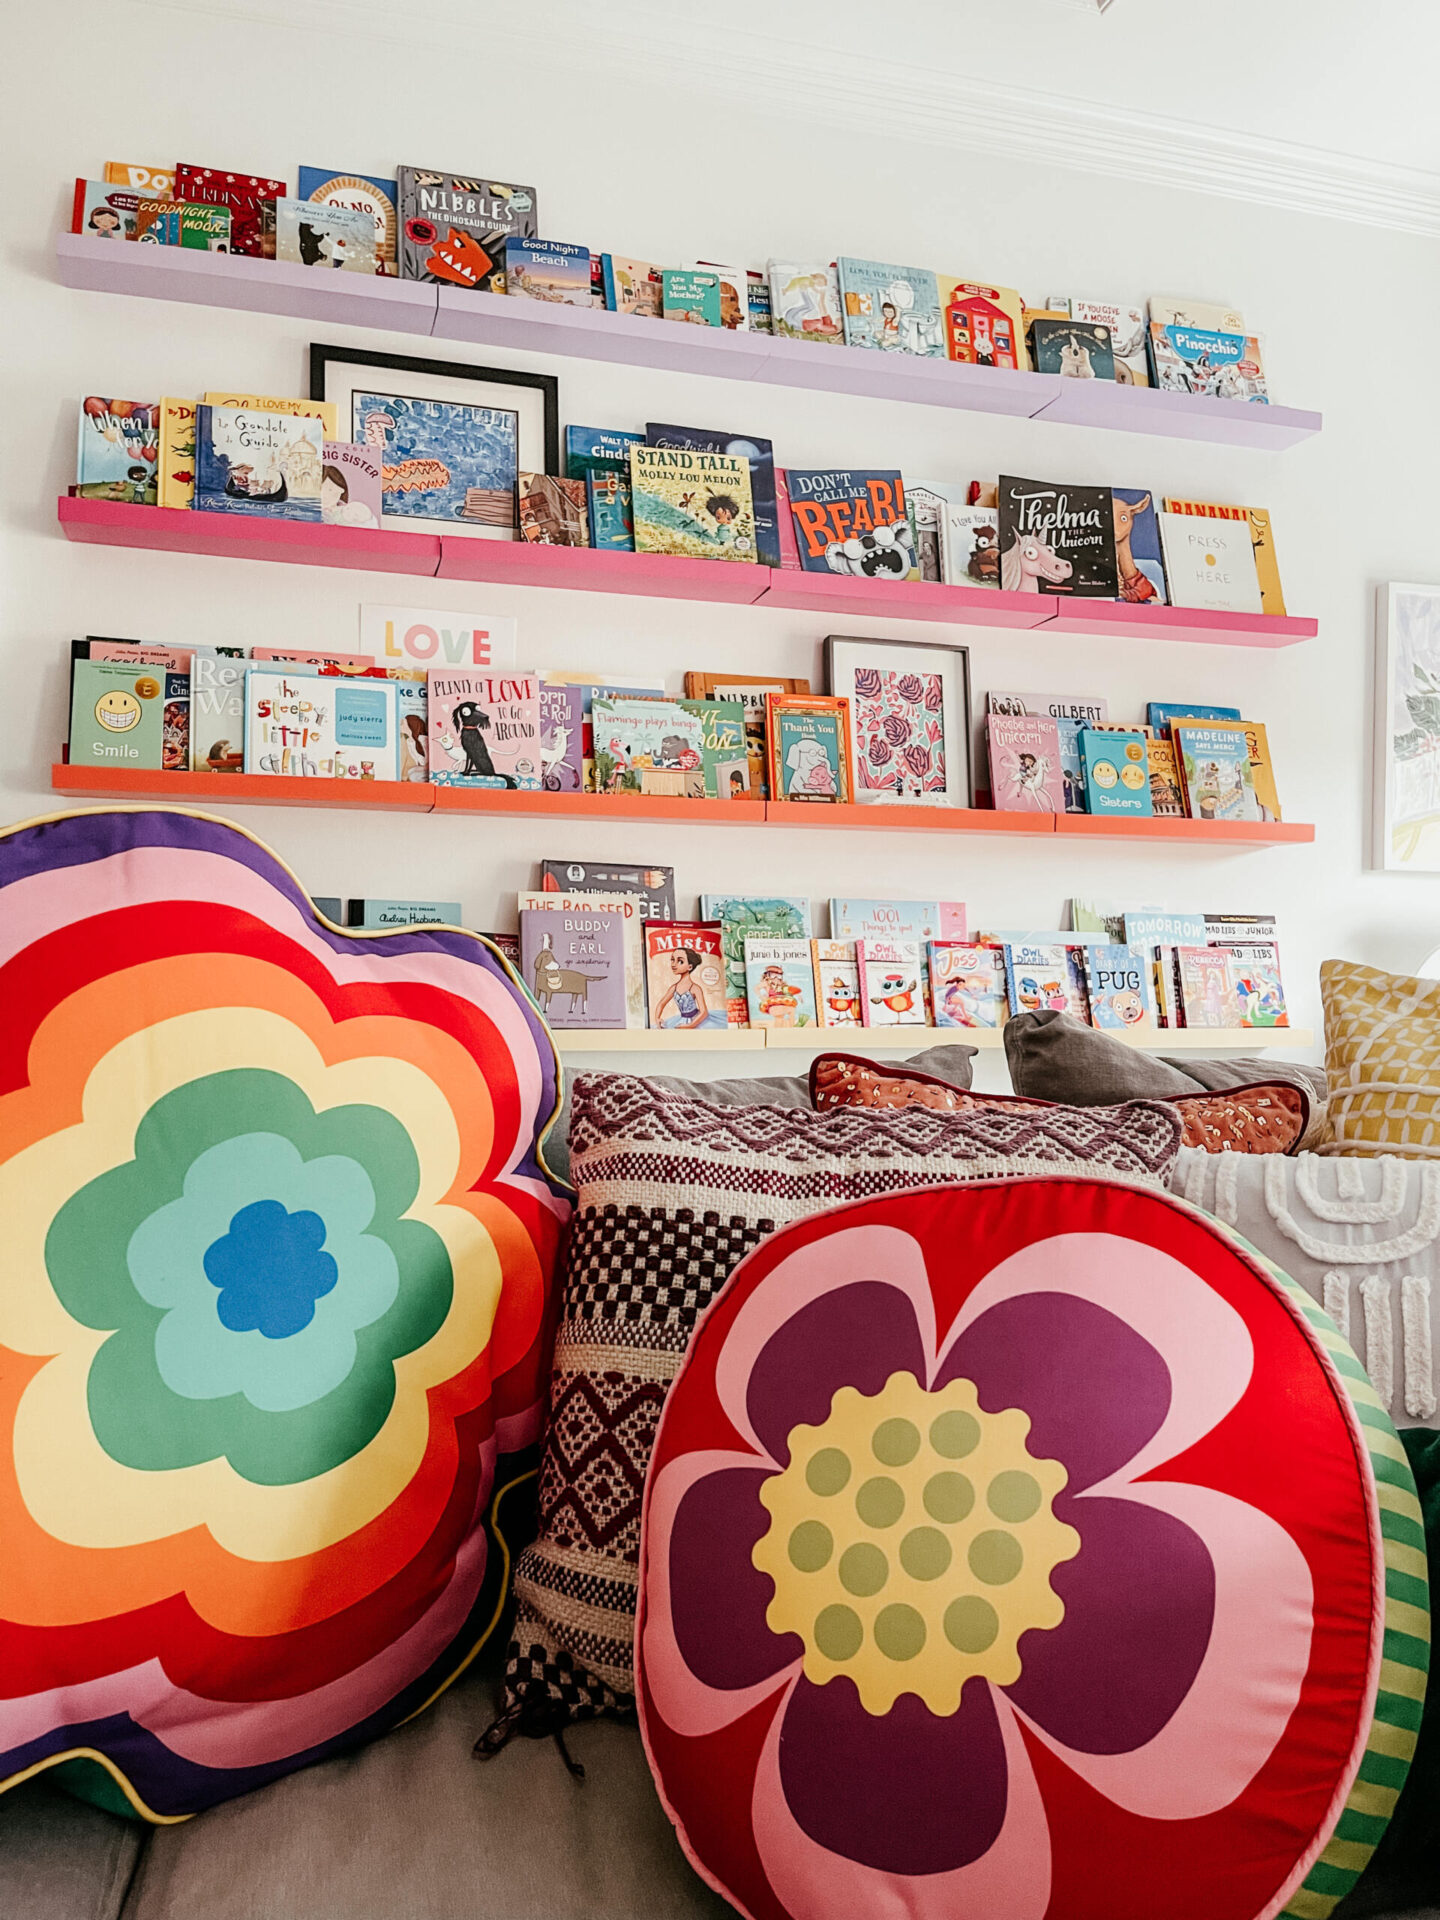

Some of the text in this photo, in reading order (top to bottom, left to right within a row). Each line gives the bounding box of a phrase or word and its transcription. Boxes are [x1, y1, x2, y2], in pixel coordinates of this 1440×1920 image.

[140, 202, 217, 219] GOODNIGHT
[421, 189, 513, 221] NIBBLES
[183, 220, 230, 233] MOON
[428, 211, 512, 232] THE DINOSAUR GUIDE
[522, 240, 579, 255] Good Night
[532, 253, 568, 267] Beach
[1078, 303, 1120, 315] IF YOU GIVE
[1090, 314, 1116, 324] MOOSE
[1175, 334, 1239, 356] Pinocchio
[263, 400, 284, 410] LOVE
[285, 402, 301, 411] MY
[88, 410, 144, 433] When
[600, 435, 621, 446] WALT
[342, 453, 379, 479] SISTER
[637, 449, 693, 470] STAND
[639, 470, 740, 486] MOLLY LOU MELON
[797, 473, 851, 494] DON'T
[814, 487, 868, 502] CALL ME
[1010, 488, 1103, 531] Thelma
[791, 479, 906, 557] BEAR!
[1052, 530, 1104, 549] Unicorn
[1068, 529, 1085, 537] THE
[1189, 535, 1227, 549] PRESS
[1196, 570, 1231, 584] HERE
[385, 621, 491, 665] LOVE
[434, 679, 472, 697] PLENTY
[485, 679, 535, 703] LOVE
[552, 706, 572, 725] Roll
[1049, 704, 1102, 721] GILBERT
[495, 723, 535, 741] AROUND
[597, 715, 697, 734] Flamingo plays bingo
[783, 722, 834, 734] Thank You
[992, 718, 1025, 731] Phoebe
[1037, 720, 1056, 734] Her
[995, 728, 1043, 747] Unicorn
[1186, 730, 1241, 743] MADELINE
[93, 742, 140, 758] Smile
[1100, 795, 1142, 809] Sisters
[563, 899, 592, 912] BAD
[600, 902, 633, 918] SEED
[873, 909, 899, 922] 1001
[380, 913, 407, 926] Audrey
[564, 919, 610, 933] BUDDY
[1128, 918, 1204, 937] TOMORROW
[737, 925, 784, 942] General
[1205, 926, 1220, 935] MAD
[1245, 926, 1274, 936] JUNIOR
[570, 942, 605, 954] EARL
[655, 934, 715, 955] Misty
[875, 943, 895, 953] OWL
[1022, 947, 1043, 957] OWL
[783, 948, 807, 960] jones
[1017, 956, 1049, 966] DIARIES
[1253, 949, 1272, 959] LIBS
[577, 958, 610, 968] exploring
[1098, 971, 1140, 990] PUG
